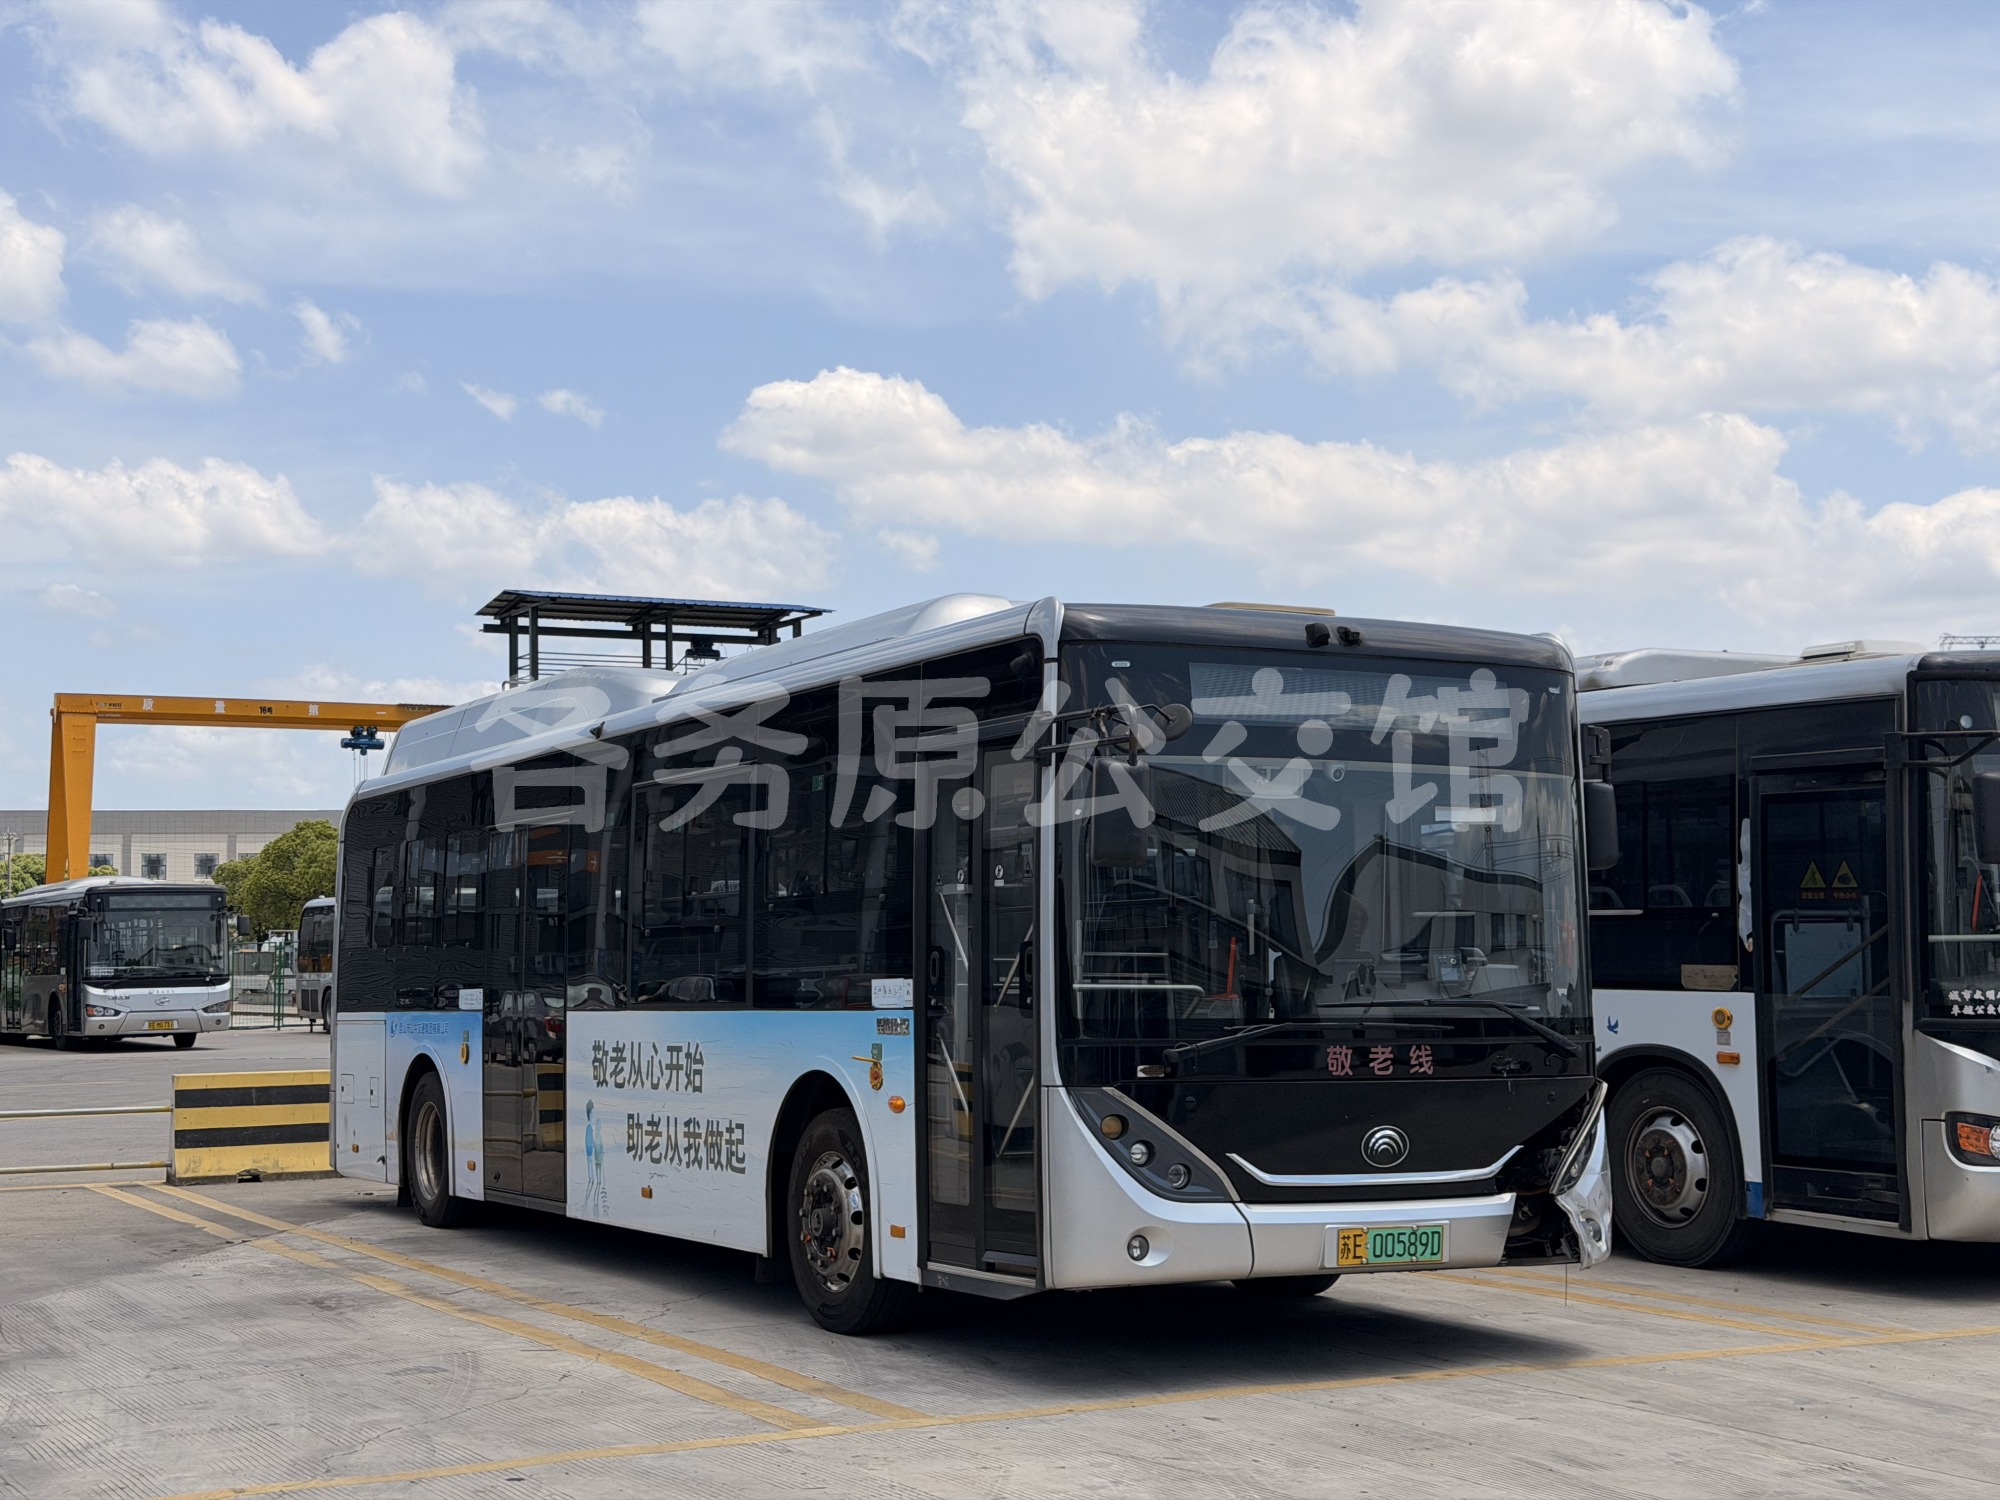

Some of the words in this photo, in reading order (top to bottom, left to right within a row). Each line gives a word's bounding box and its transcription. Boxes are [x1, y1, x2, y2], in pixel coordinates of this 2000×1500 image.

[592, 1040, 704, 1093] 敬老从心开始
[1326, 1045, 1434, 1076] 敬老线
[627, 1112, 746, 1174] 助老从我做起
